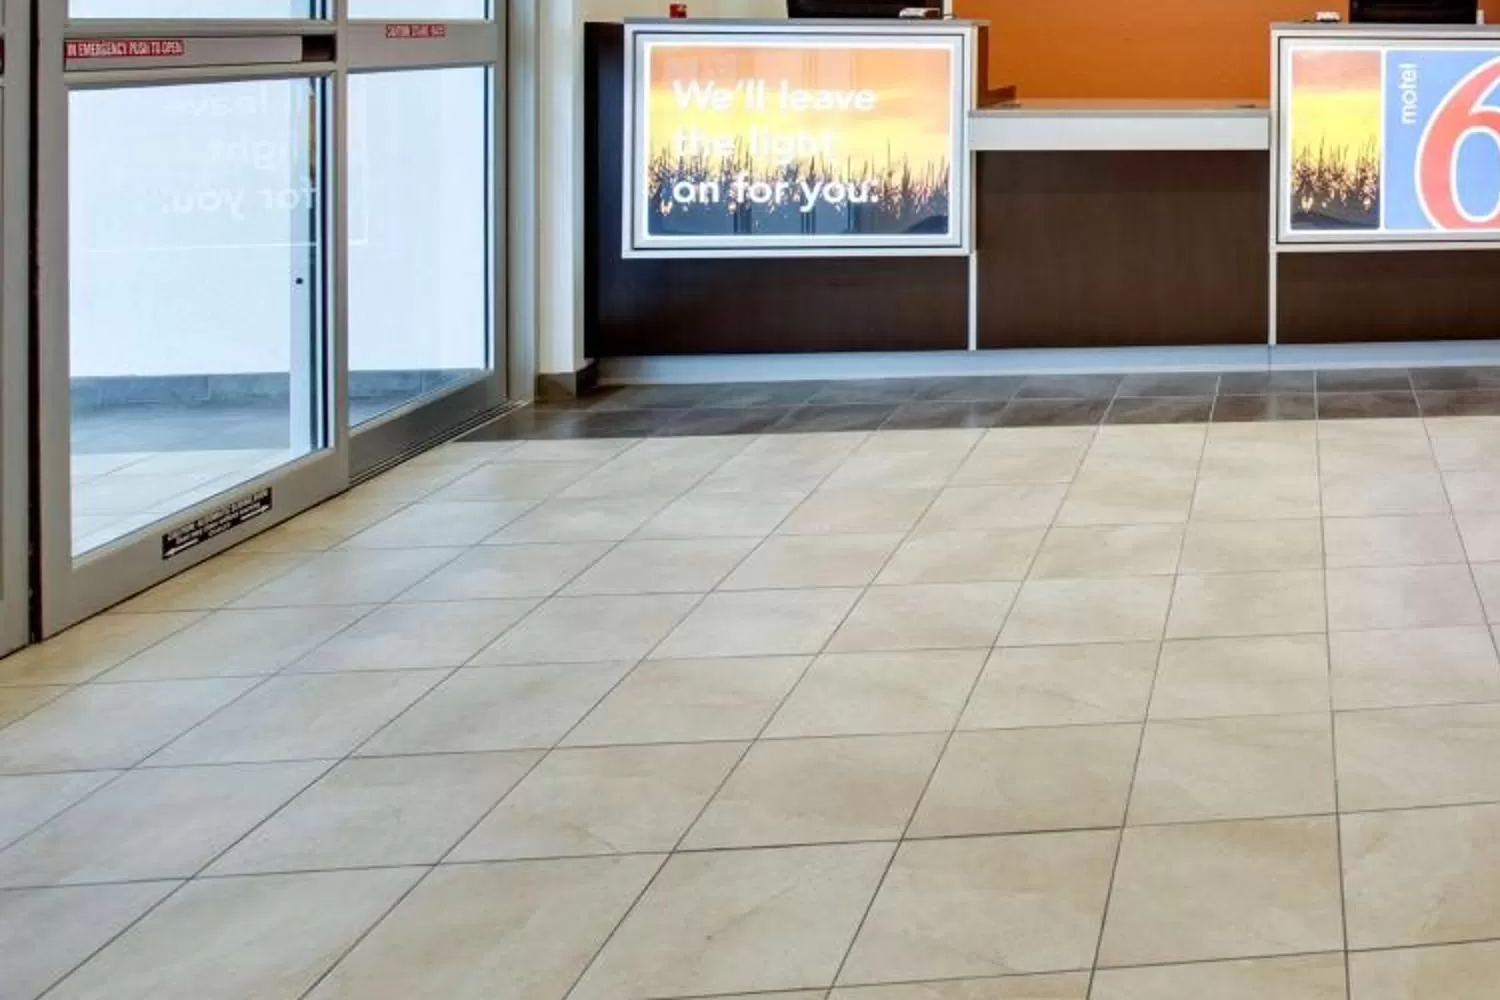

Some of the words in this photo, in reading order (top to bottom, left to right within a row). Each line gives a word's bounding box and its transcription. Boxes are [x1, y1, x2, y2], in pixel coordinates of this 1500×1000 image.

[672, 79, 765, 112] We'll
[778, 79, 879, 111] leave
[1397, 63, 1418, 125] motel
[673, 126, 736, 157] the
[749, 124, 835, 165] light
[672, 179, 720, 204] on
[733, 170, 789, 204] for
[799, 177, 879, 214] you.
